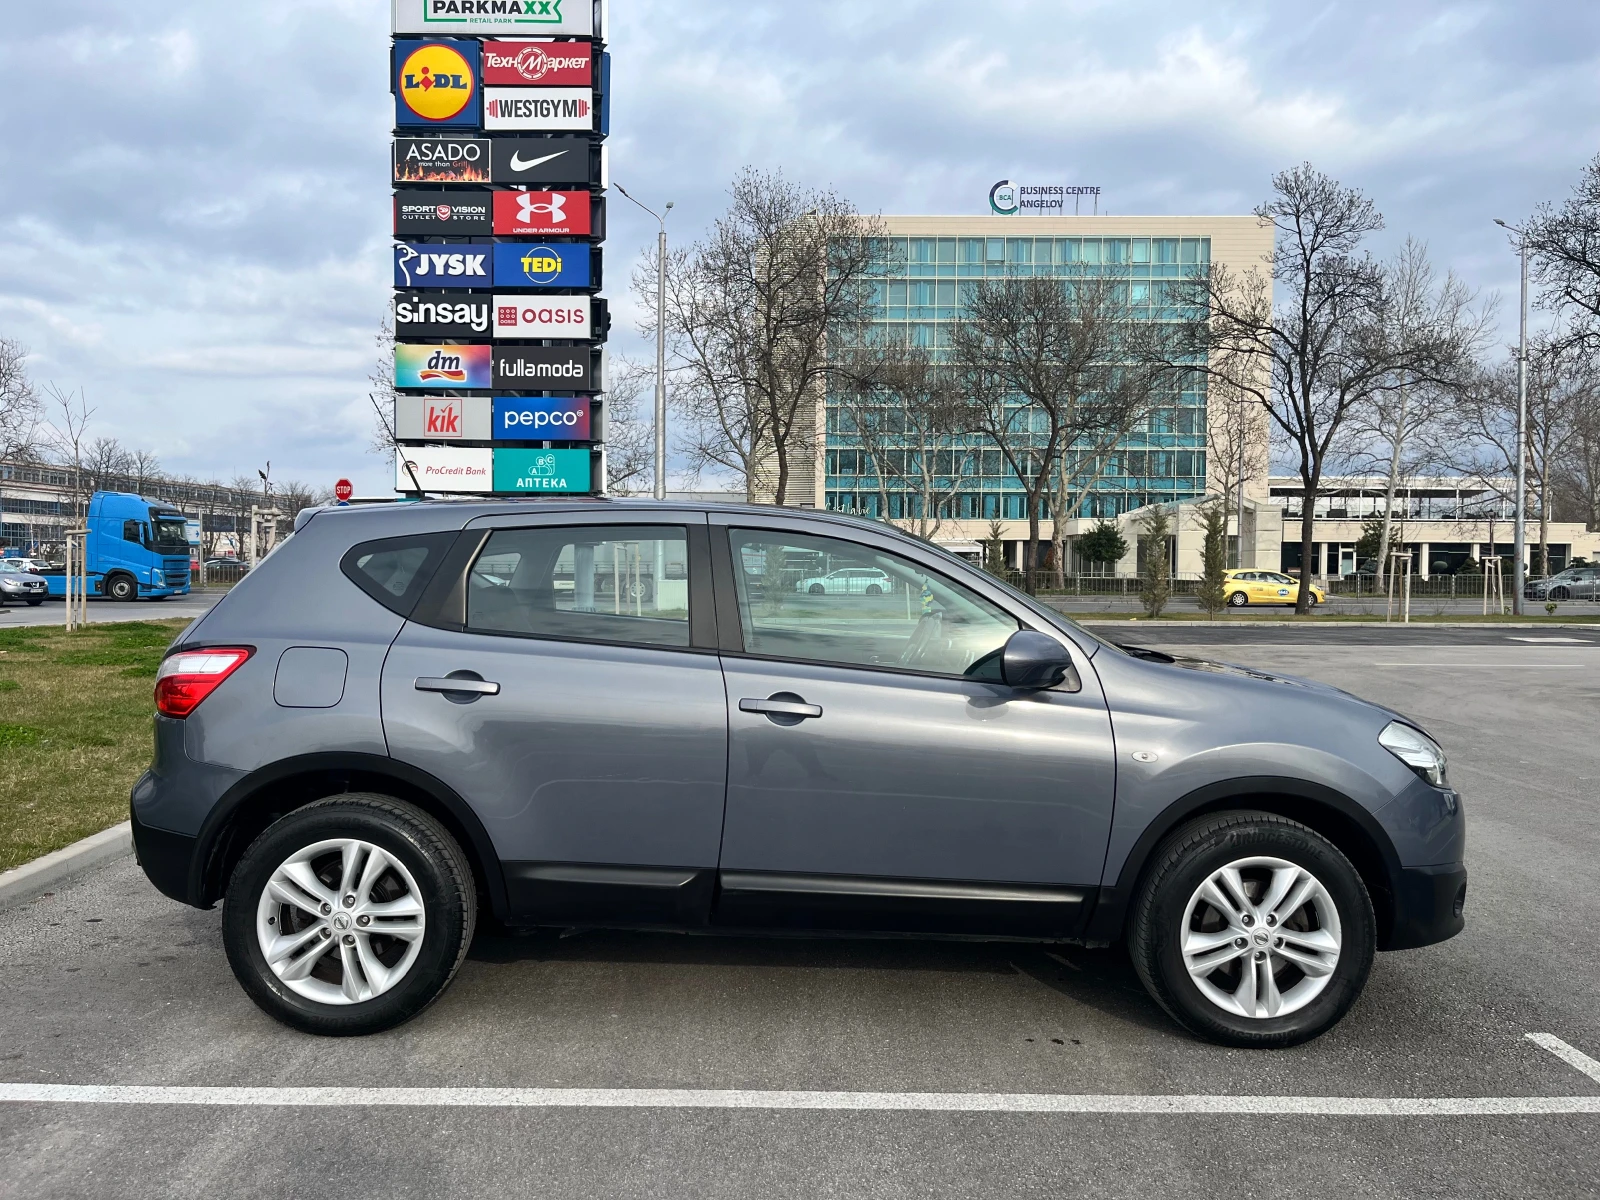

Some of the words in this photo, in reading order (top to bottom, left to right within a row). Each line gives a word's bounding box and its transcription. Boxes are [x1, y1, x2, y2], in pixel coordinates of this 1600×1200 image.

[433, 1, 551, 15] PARKMAXX
[498, 99, 578, 119] WESTGYM
[406, 142, 480, 161] ASADO
[1020, 186, 1064, 195] BUSINESS
[1066, 186, 1101, 195] CENTRE
[402, 205, 436, 213] SPORT
[1020, 199, 1064, 208] ANGELOV
[416, 254, 487, 276] JYSK
[521, 256, 562, 273] TEDi
[397, 297, 488, 332] sinsay
[522, 308, 584, 324] oasis
[428, 351, 460, 370] dm
[500, 359, 584, 377] fullamoda
[428, 403, 459, 432] kik
[426, 466, 464, 476] ProCredit
[466, 467, 486, 476] Bank
[336, 486, 351, 494] STOP
[516, 478, 567, 488] АПТЕКА
[1230, 832, 1326, 860] BRIDGESTONE
